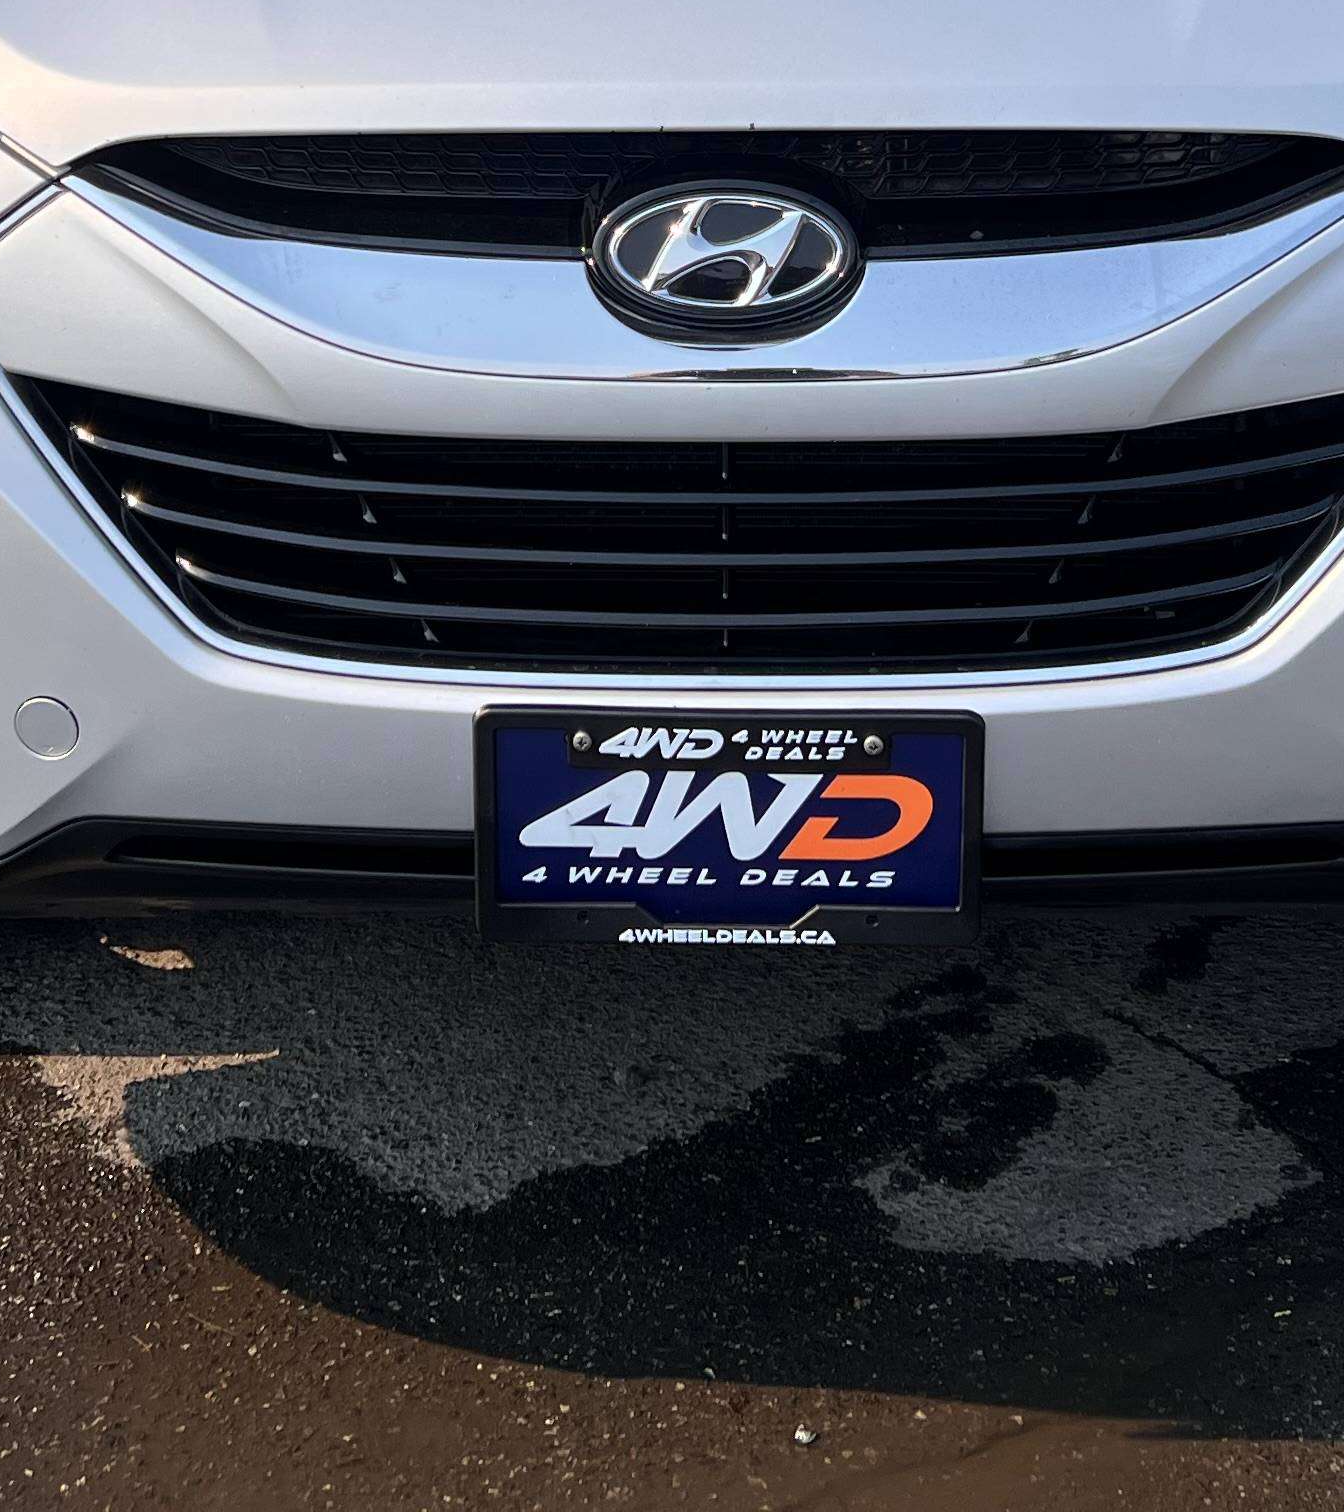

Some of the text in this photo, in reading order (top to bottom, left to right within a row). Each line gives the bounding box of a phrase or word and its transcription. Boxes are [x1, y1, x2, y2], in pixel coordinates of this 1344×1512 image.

[598, 726, 858, 760] 4WD 4 WHEEL
[744, 746, 846, 762] DEALS
[518, 769, 934, 862] 4WD
[521, 866, 896, 889] 4 WHEEL DEALS
[618, 928, 836, 946] 4WHEELDEALS.CA
